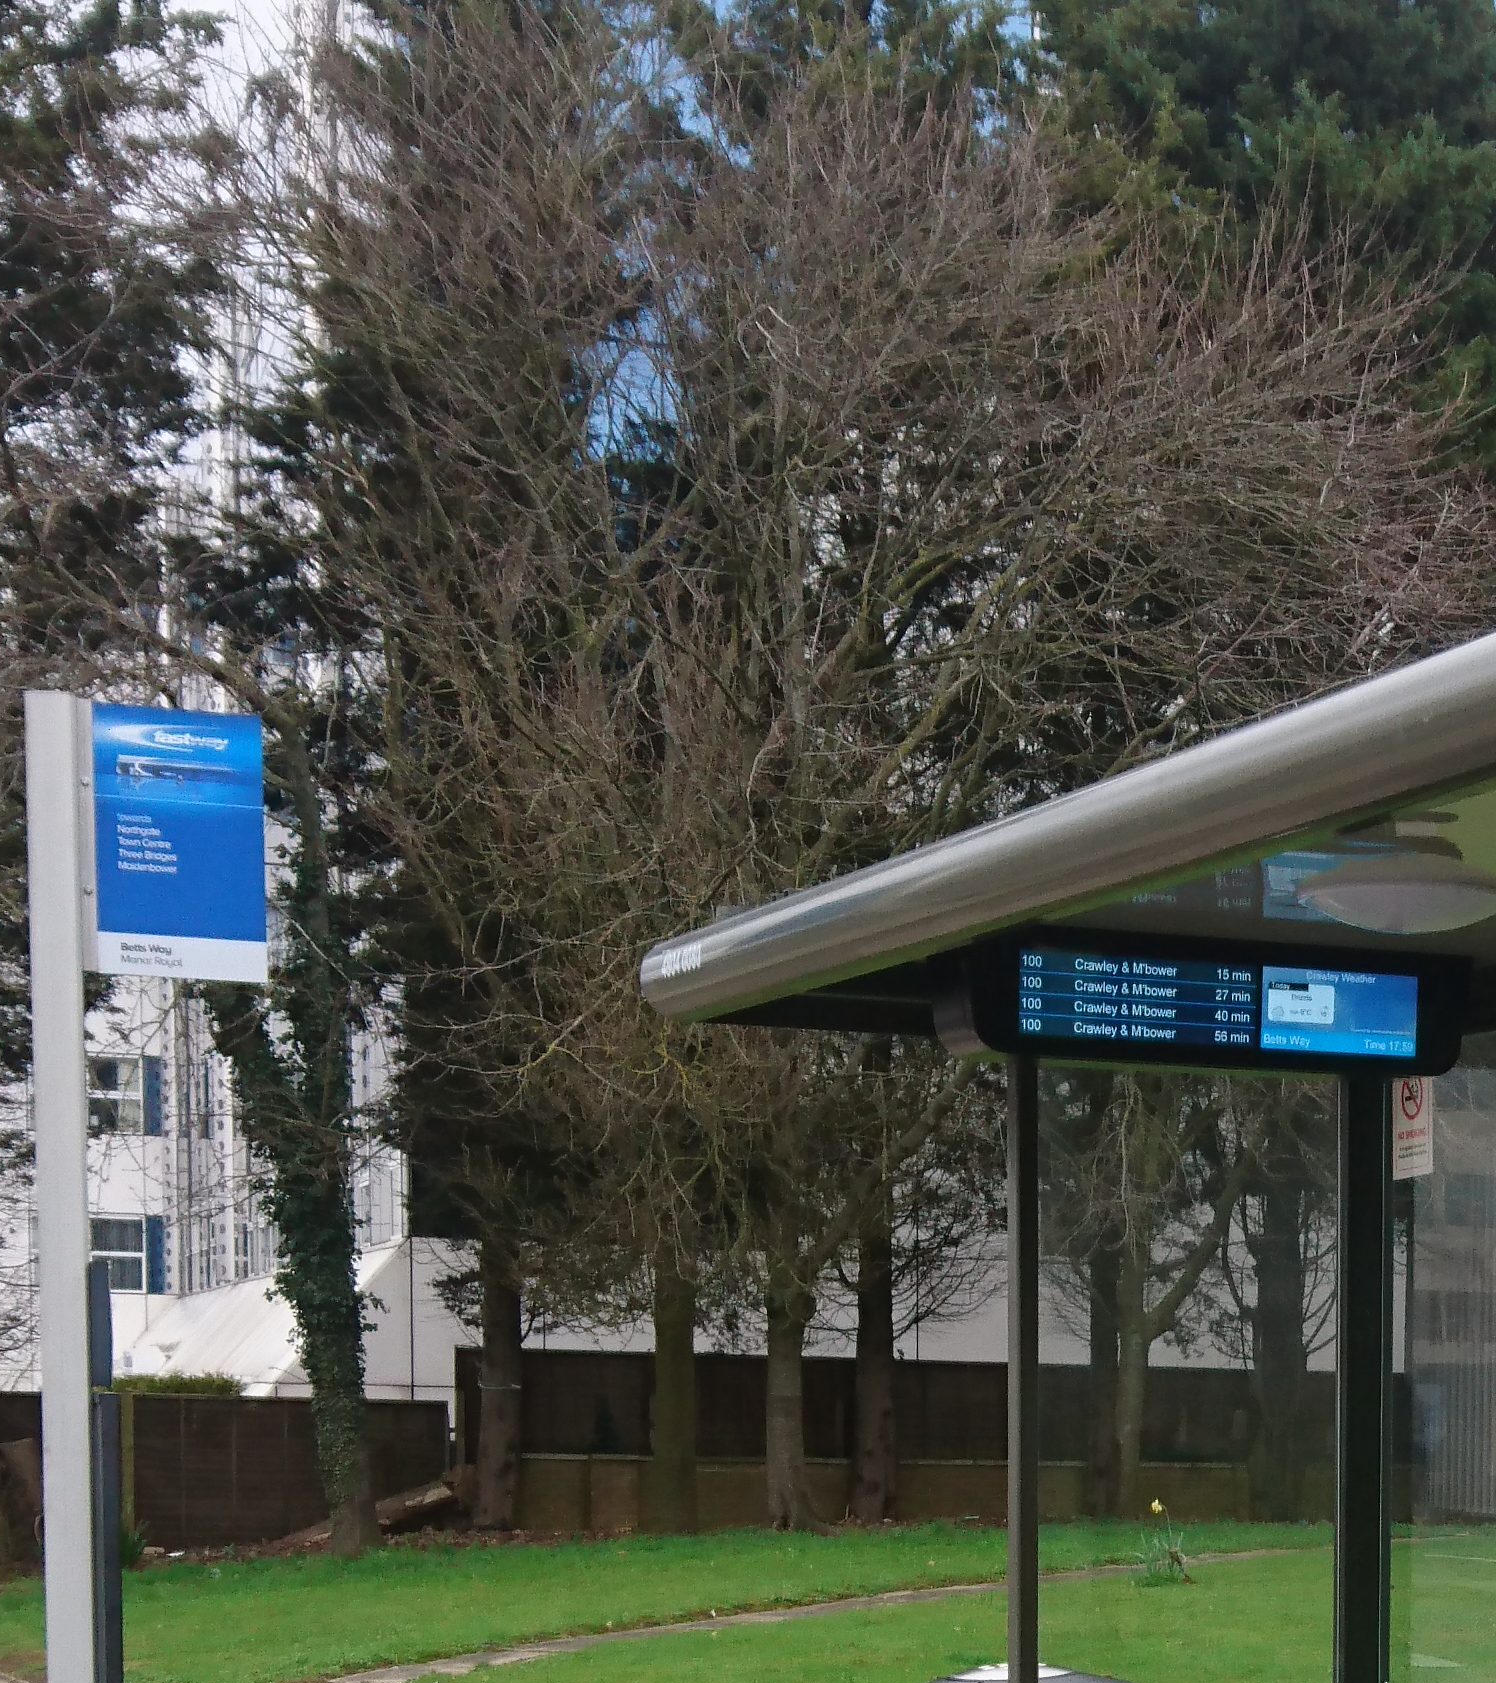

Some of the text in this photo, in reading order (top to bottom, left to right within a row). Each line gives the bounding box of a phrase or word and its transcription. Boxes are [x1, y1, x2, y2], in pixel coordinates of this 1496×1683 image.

[118, 837, 141, 847] Town
[118, 849, 178, 863] Three Bridges
[120, 942, 172, 957] Betts Way
[154, 957, 183, 969] Royal
[1021, 954, 1043, 969] 100
[1075, 958, 1119, 975] Crawley
[1121, 962, 1130, 973] &
[1217, 968, 1230, 981] 15
[1232, 970, 1251, 982] min
[1306, 971, 1377, 984] Crawley Weather
[1021, 976, 1042, 989] 100
[1074, 980, 1118, 996] Crawley
[1121, 983, 1129, 994] &
[1215, 989, 1230, 1002] 27
[1231, 991, 1251, 1003] min
[1021, 997, 1042, 1010] 100
[1074, 1001, 1118, 1017] Crawley
[1120, 1003, 1129, 1015] &
[1214, 1010, 1229, 1022] 40
[1231, 1012, 1250, 1024] min
[1021, 1019, 1041, 1032] 100
[1073, 1022, 1117, 1038] Crawley
[1120, 1024, 1129, 1036] &
[1214, 1031, 1228, 1042] 56
[1230, 1032, 1250, 1044] min
[1263, 1034, 1287, 1045] Betts
[1289, 1035, 1311, 1048] Way
[1365, 1039, 1386, 1050] Time
